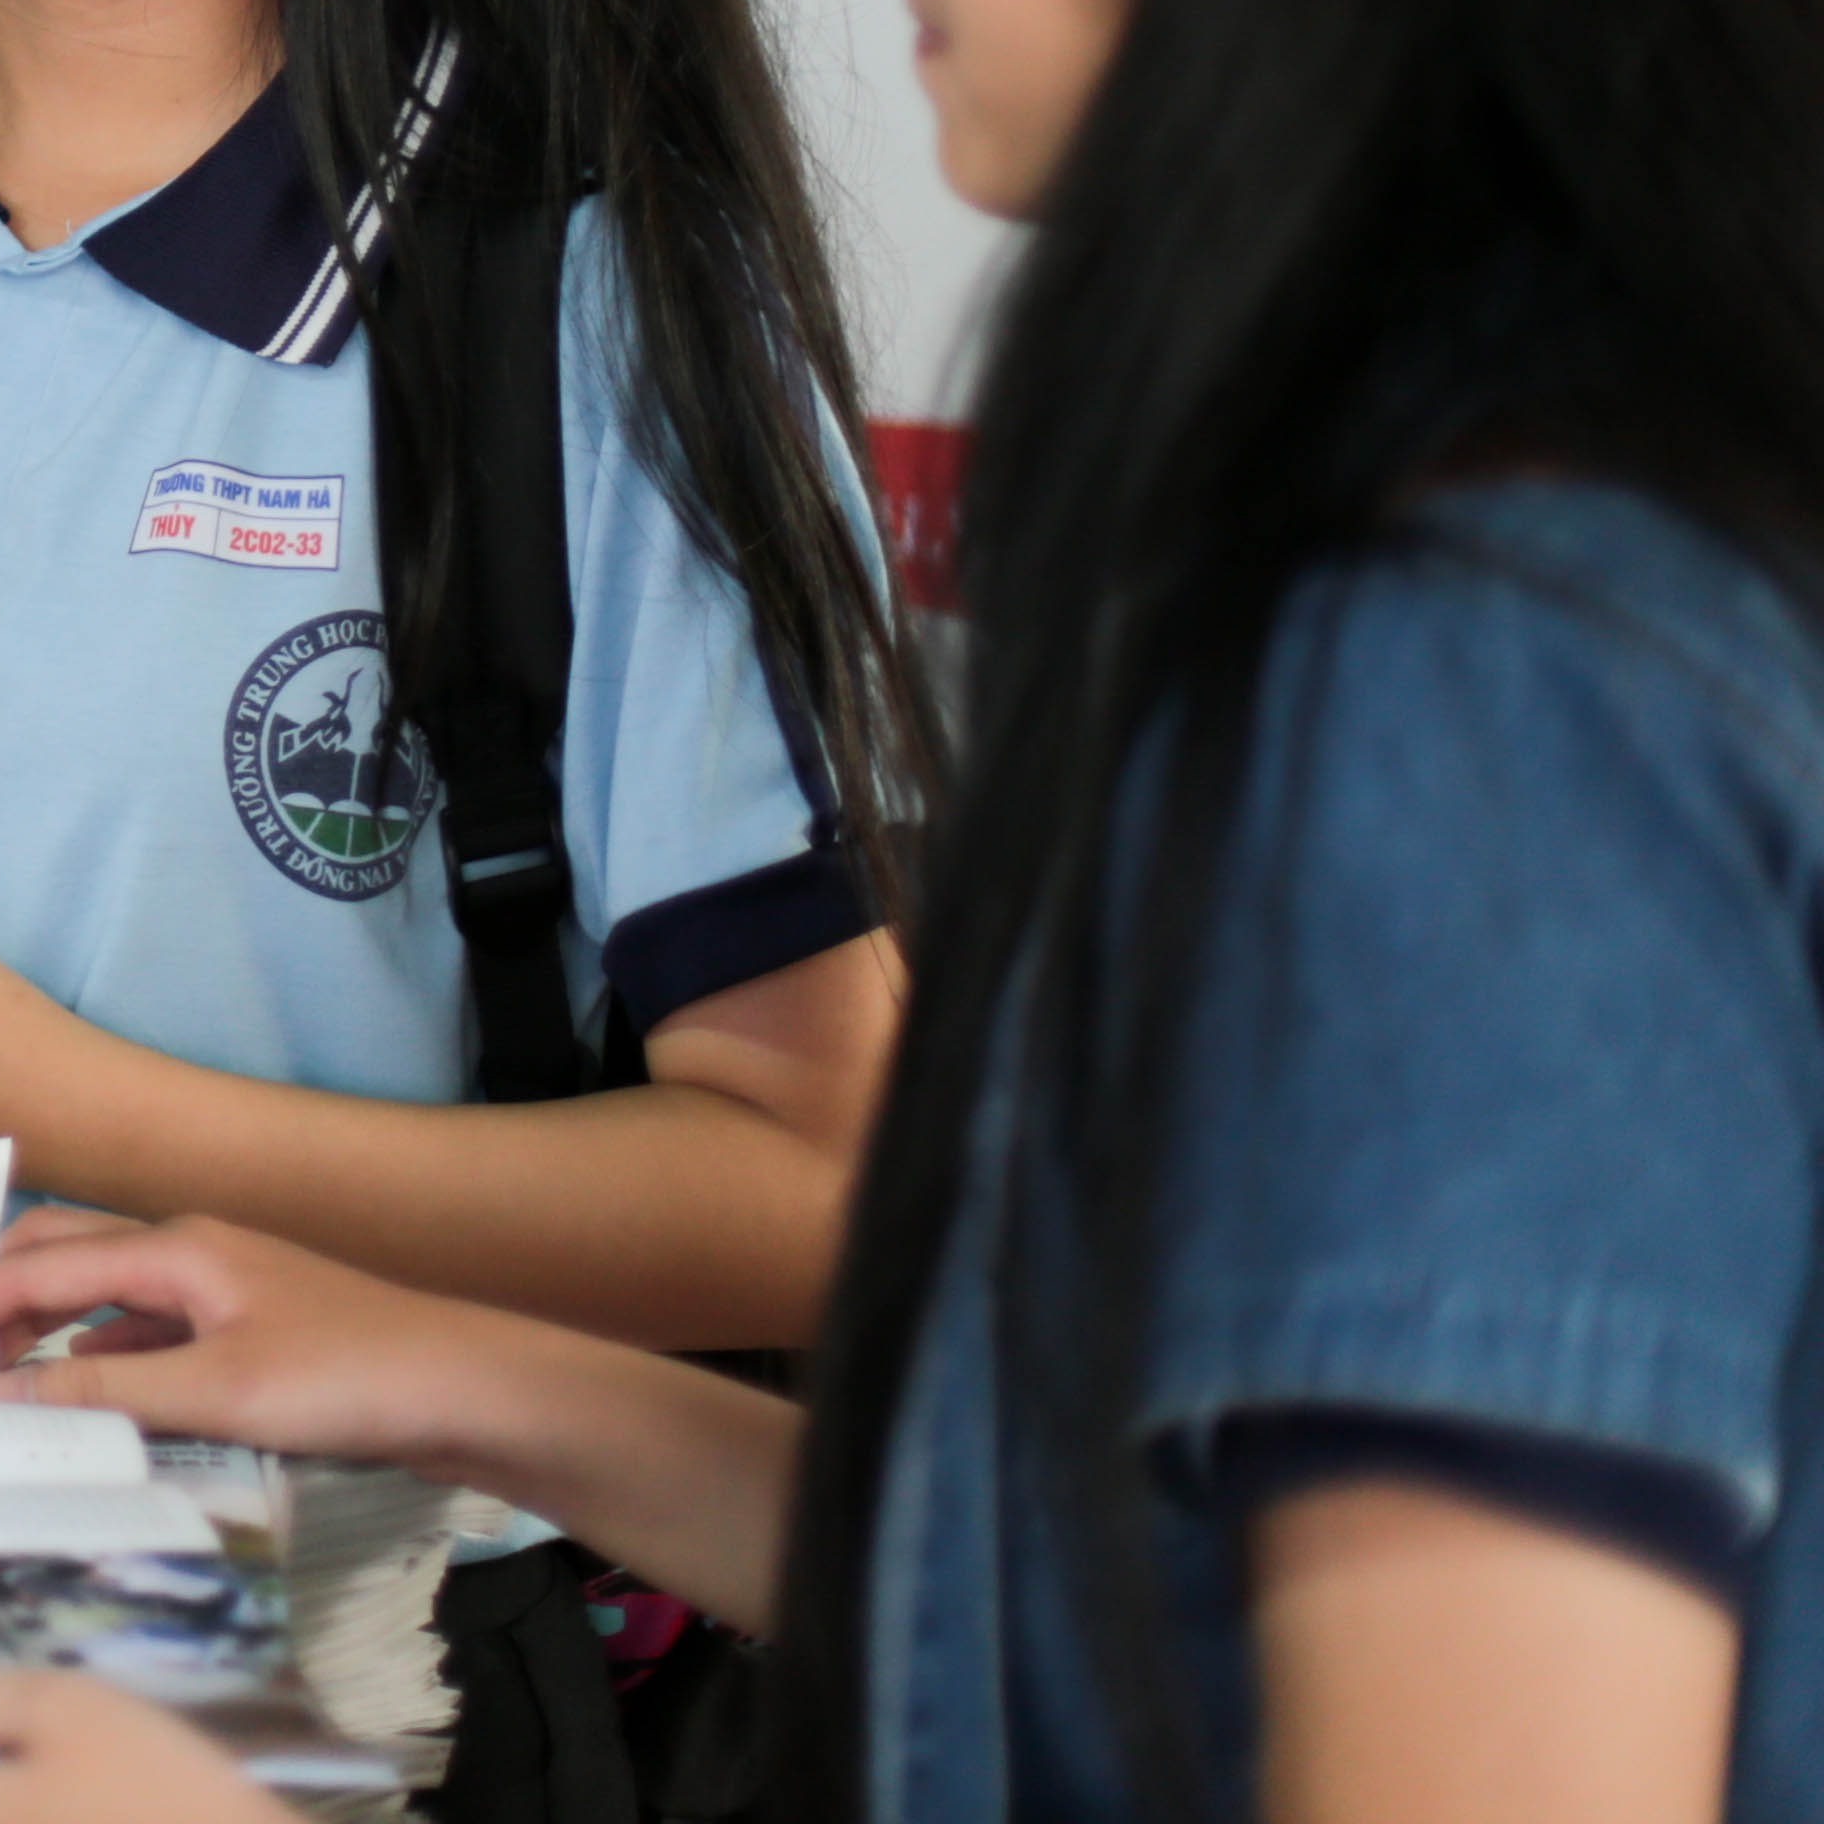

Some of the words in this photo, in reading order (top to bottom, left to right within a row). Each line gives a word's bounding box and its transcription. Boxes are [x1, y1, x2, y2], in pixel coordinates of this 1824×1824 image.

[211, 475, 253, 505] THPT
[257, 487, 301, 510] NAM
[228, 526, 324, 557] 2C02-33
[236, 632, 315, 724] TRUNG
[317, 618, 372, 648] HỌC
